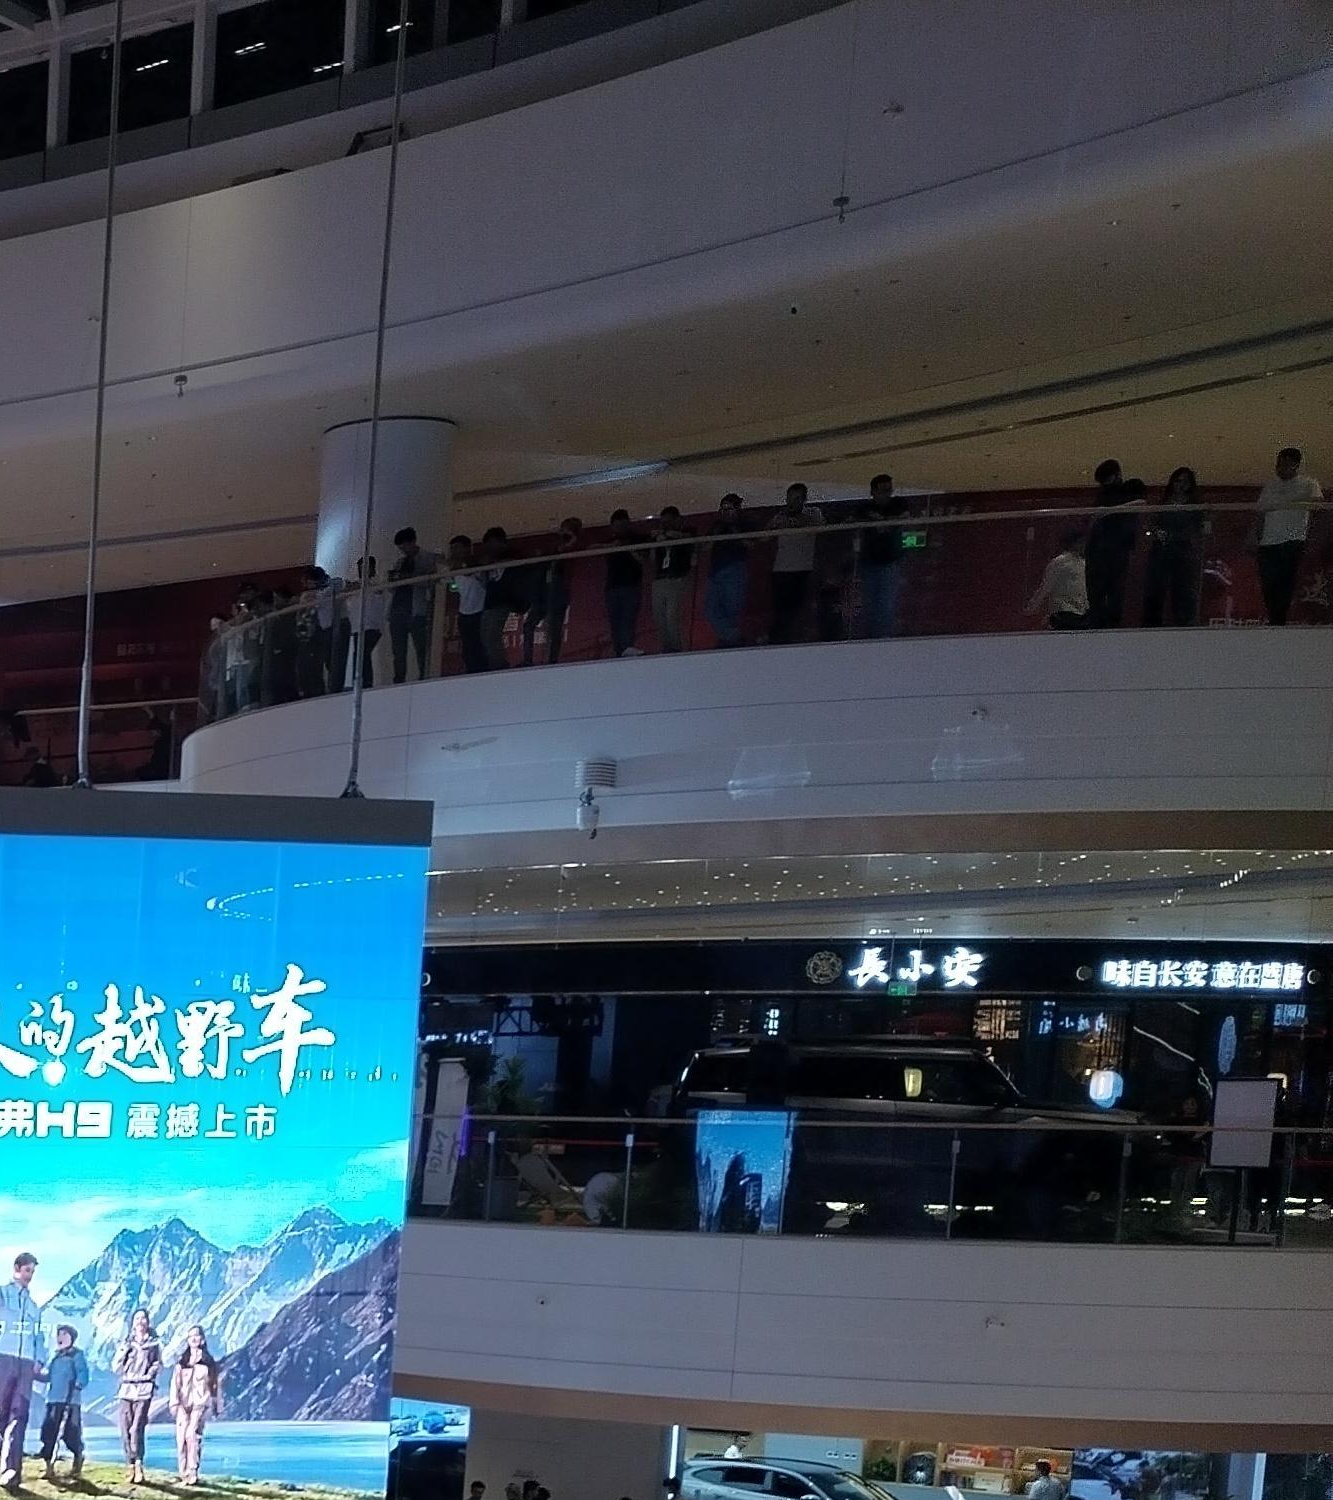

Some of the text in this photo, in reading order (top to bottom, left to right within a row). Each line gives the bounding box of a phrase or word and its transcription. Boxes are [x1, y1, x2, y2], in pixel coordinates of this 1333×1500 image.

[1101, 958, 1209, 988] 味自长安
[126, 1102, 279, 1141] 震撼上市
